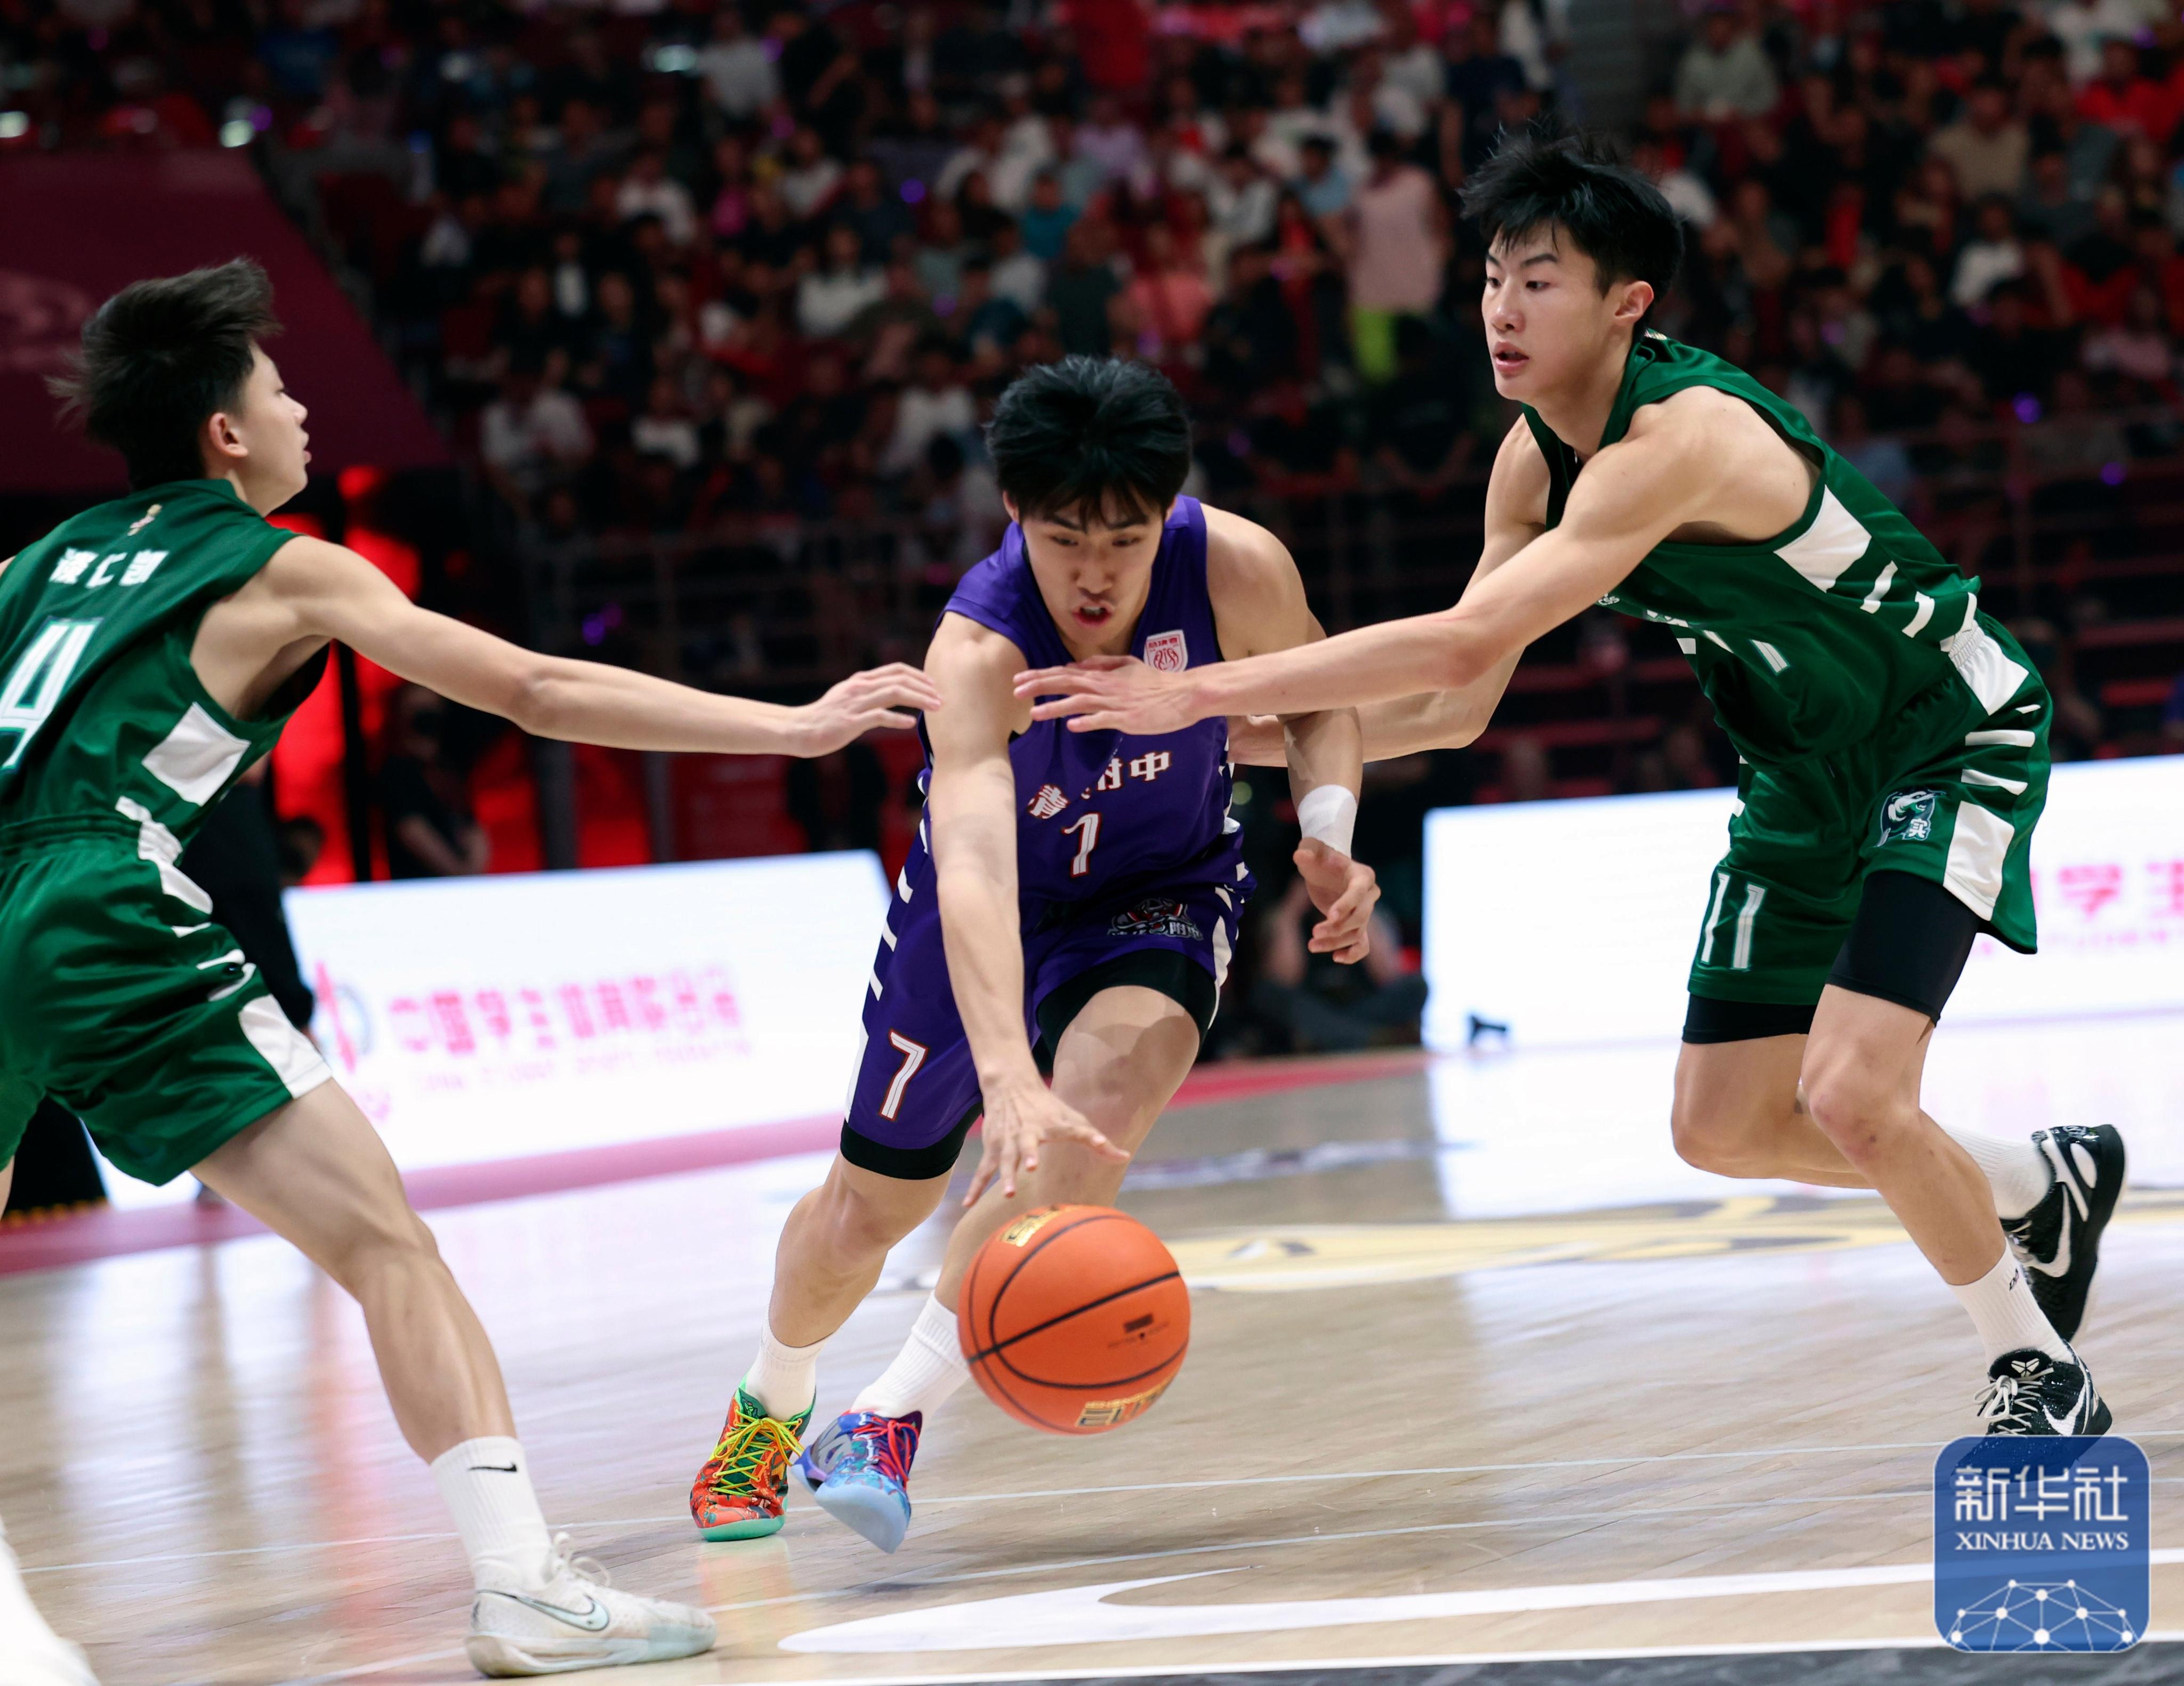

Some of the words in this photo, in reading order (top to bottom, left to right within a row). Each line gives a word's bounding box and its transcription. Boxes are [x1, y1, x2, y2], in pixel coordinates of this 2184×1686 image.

[0, 620, 99, 770] 4
[1701, 870, 1768, 970] 11
[880, 1029, 929, 1122] 7
